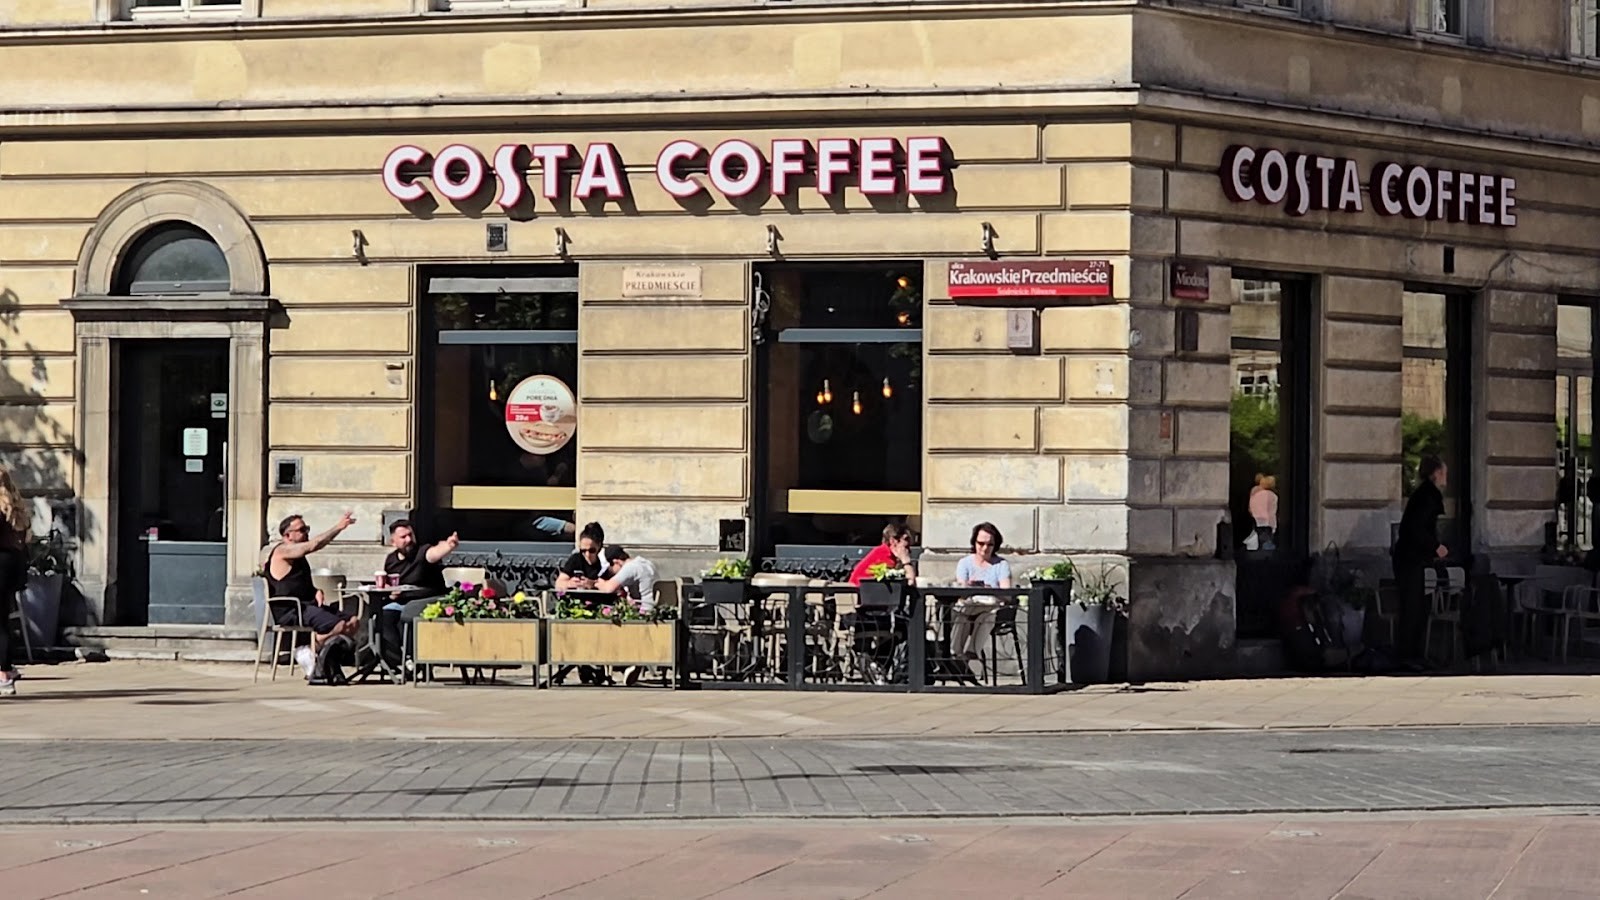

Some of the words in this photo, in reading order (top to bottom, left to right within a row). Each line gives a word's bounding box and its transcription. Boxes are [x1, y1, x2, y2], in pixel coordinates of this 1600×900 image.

[382, 143, 624, 208] COSTA
[656, 137, 945, 197] COFFEE
[1230, 146, 1363, 214] COSTA
[1380, 163, 1517, 226] COFFEE
[950, 268, 1020, 284] Krakowskie
[1021, 268, 1108, 284] Przedmieście
